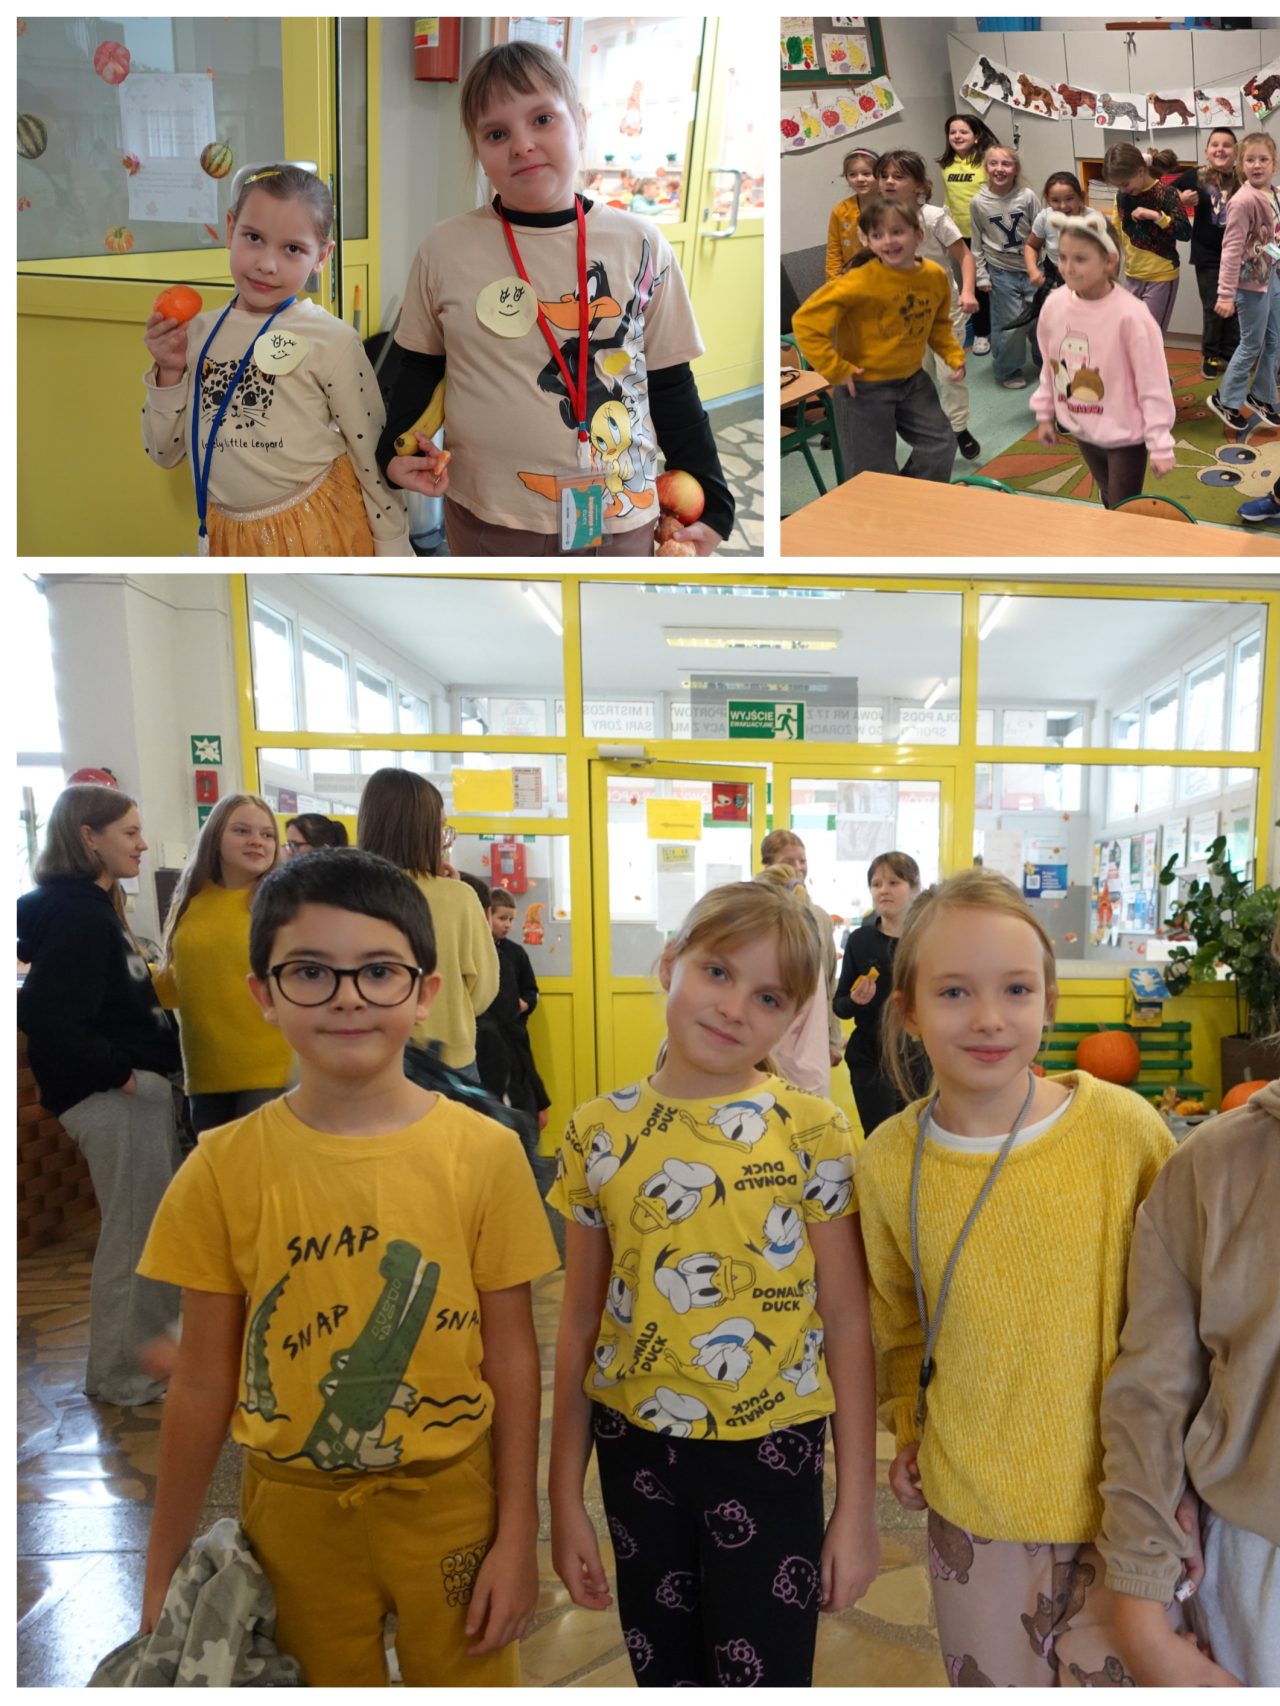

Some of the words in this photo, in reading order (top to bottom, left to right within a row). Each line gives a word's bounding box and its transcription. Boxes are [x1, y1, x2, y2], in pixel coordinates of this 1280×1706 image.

[989, 212, 1024, 249] Y
[202, 437, 224, 454] loely
[224, 437, 248, 448] little
[730, 709, 775, 721] WYJŚCIE
[742, 1160, 785, 1177] DUCK
[734, 1174, 798, 1192] DONALD
[287, 1224, 379, 1267] SNAP
[762, 1300, 801, 1313] DUCK
[282, 1303, 349, 1361] SNAP
[435, 1308, 480, 1333] SNA
[641, 1335, 668, 1373] DUCK
[725, 1391, 786, 1428] DONALD
[731, 1387, 770, 1416] DUCK
